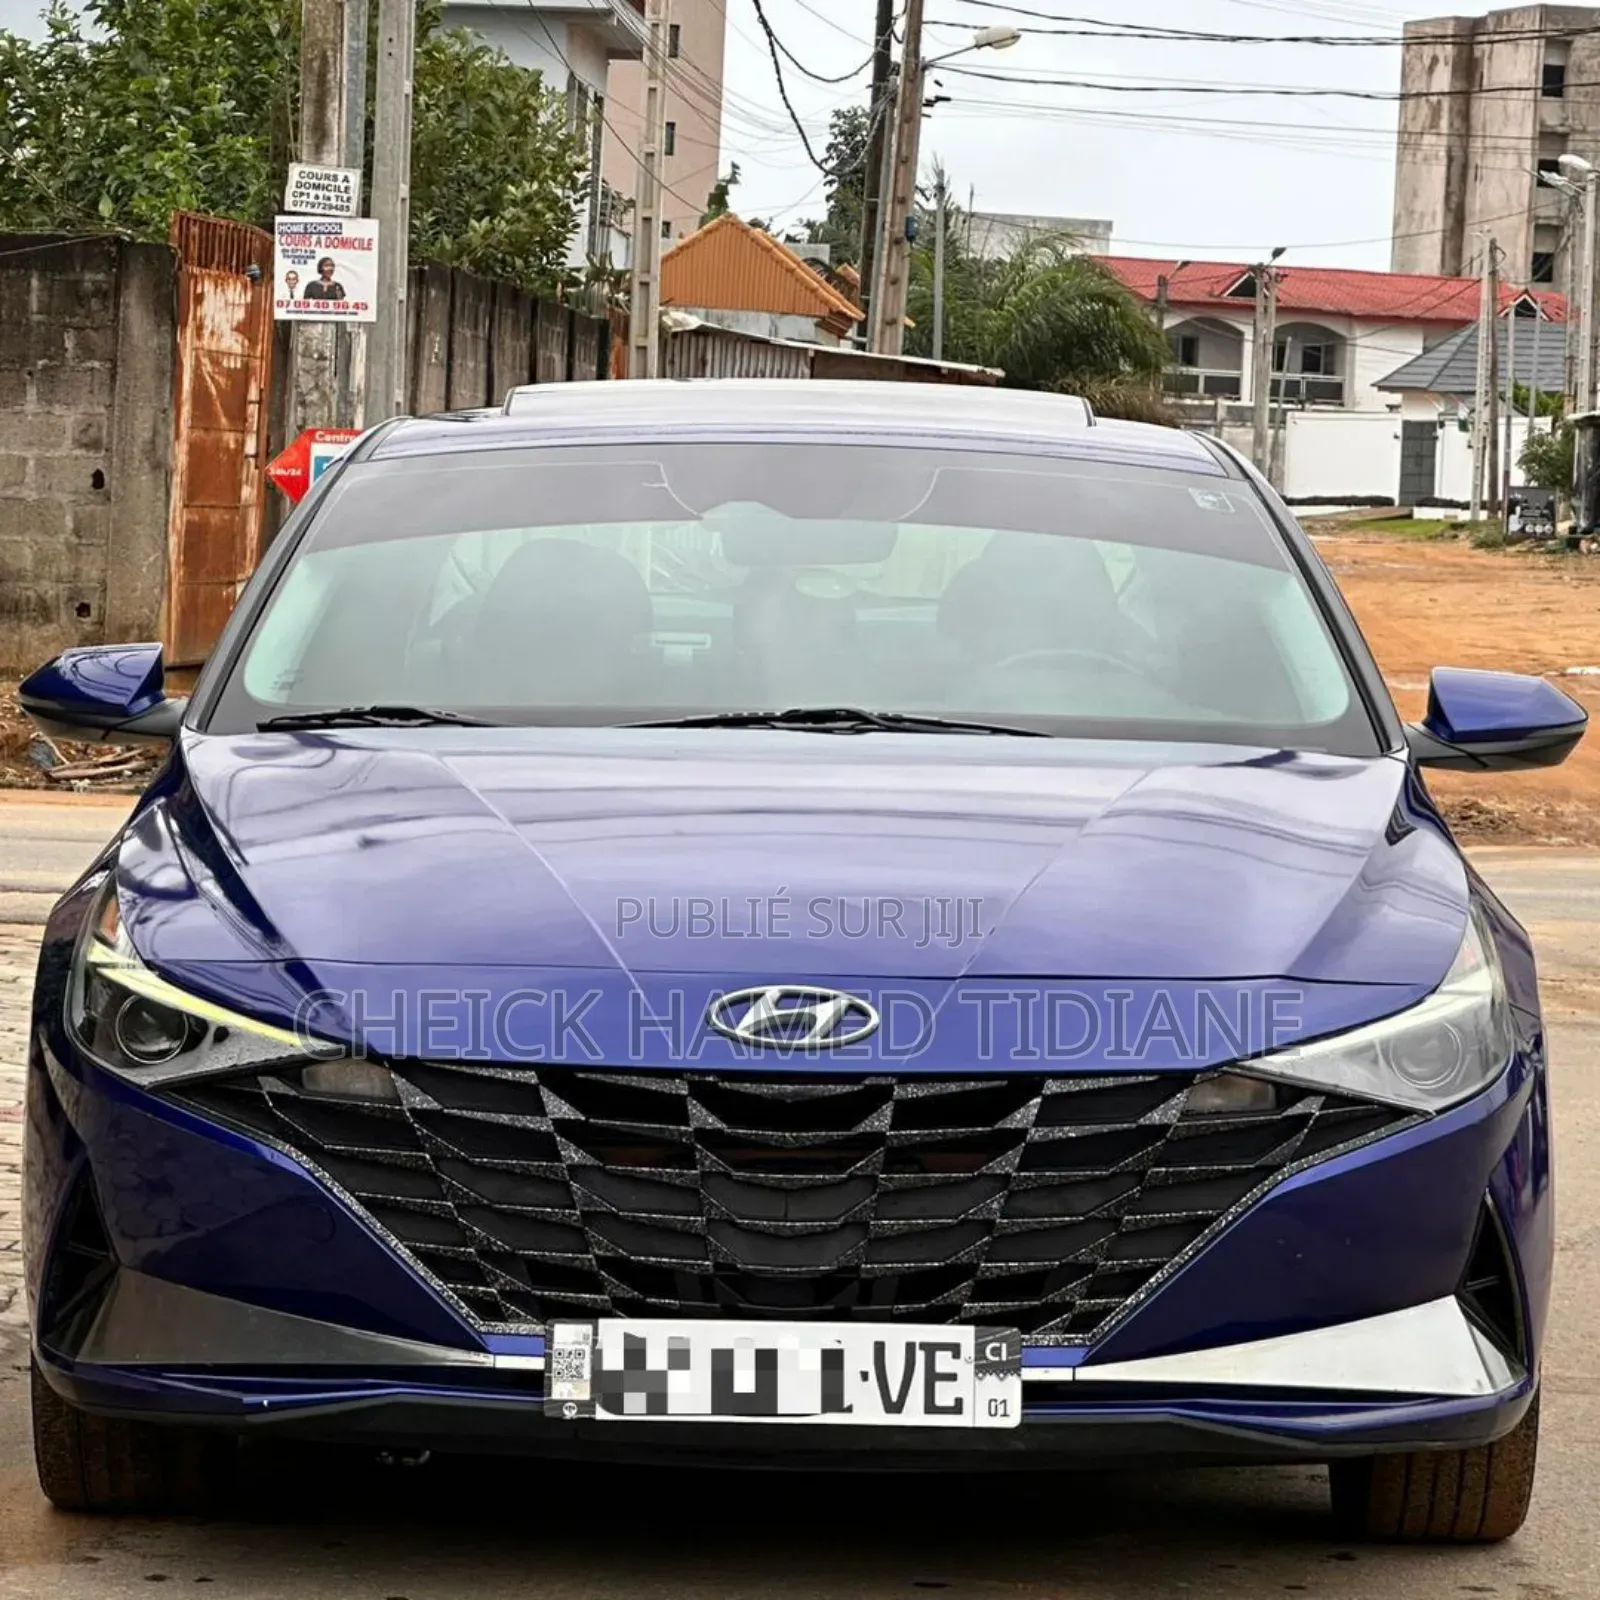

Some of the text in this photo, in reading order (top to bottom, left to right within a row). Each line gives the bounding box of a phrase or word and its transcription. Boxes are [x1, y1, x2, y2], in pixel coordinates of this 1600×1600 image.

[299, 170, 350, 183] COURS A
[295, 180, 350, 194] DOMICILE
[292, 190, 310, 200] CP1
[335, 194, 351, 203] TLE
[279, 223, 342, 233] HOME SCHOOL
[279, 233, 373, 251] COURS A DOMICILE
[276, 300, 290, 309] 07
[984, 1342, 1007, 1361] CI
[987, 1398, 1010, 1418] 01
